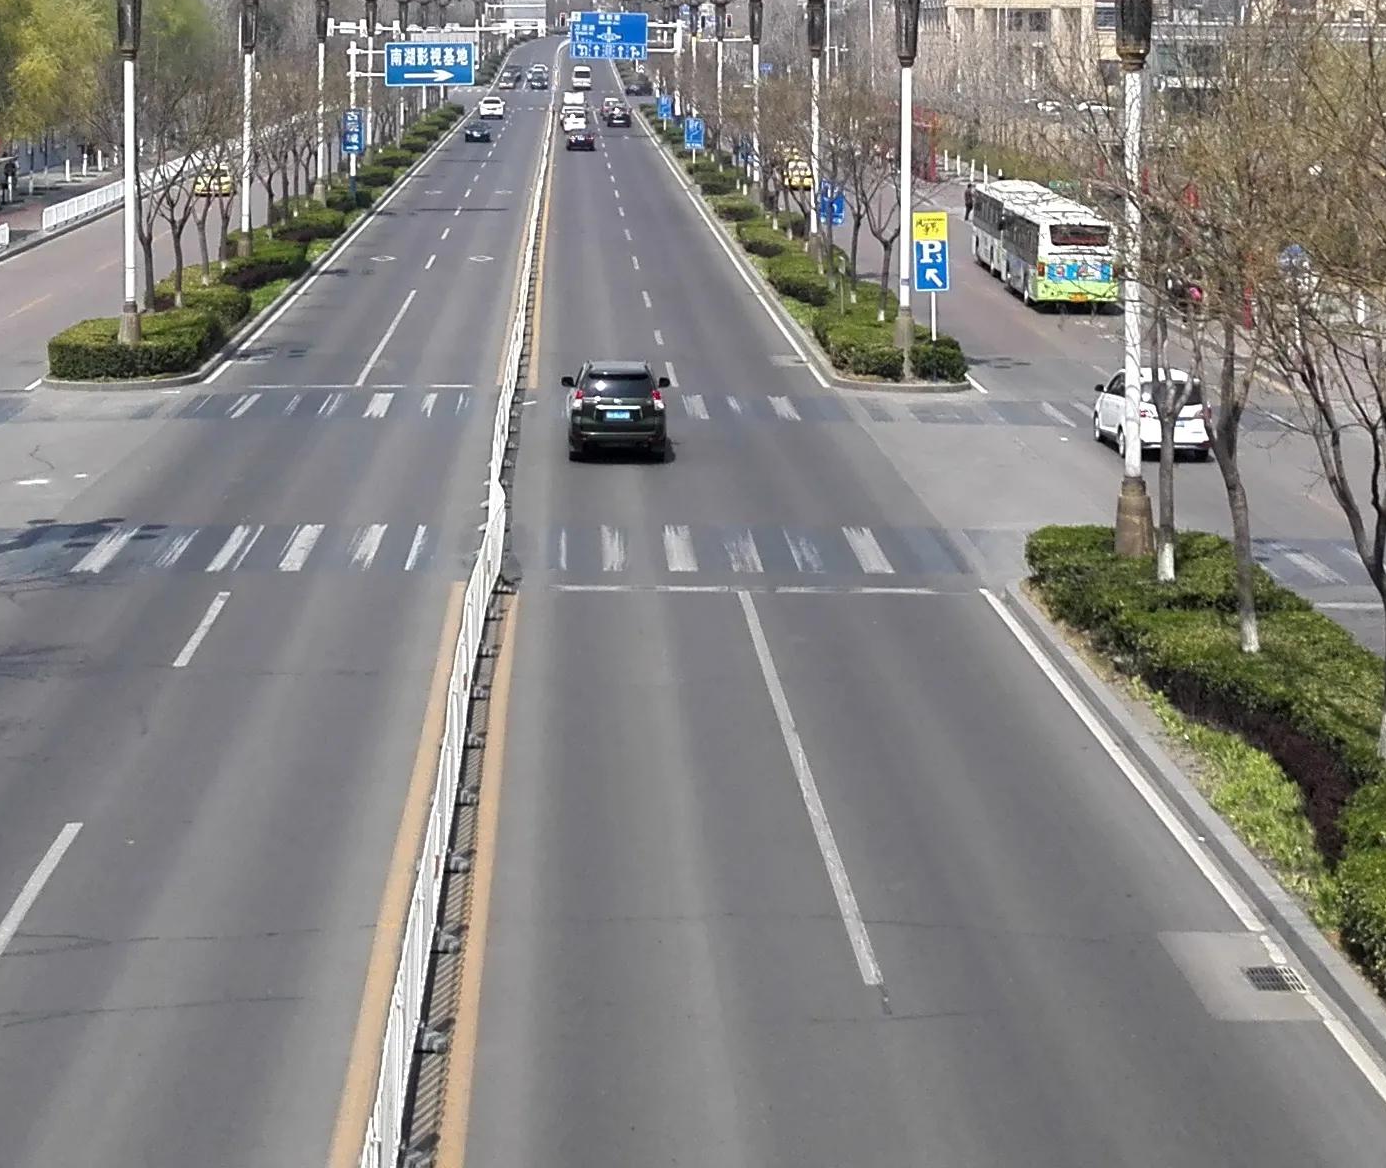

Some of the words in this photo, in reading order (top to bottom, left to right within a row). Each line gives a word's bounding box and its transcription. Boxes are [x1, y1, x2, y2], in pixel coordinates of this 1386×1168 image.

[390, 47, 468, 66] 南湖影视基地
